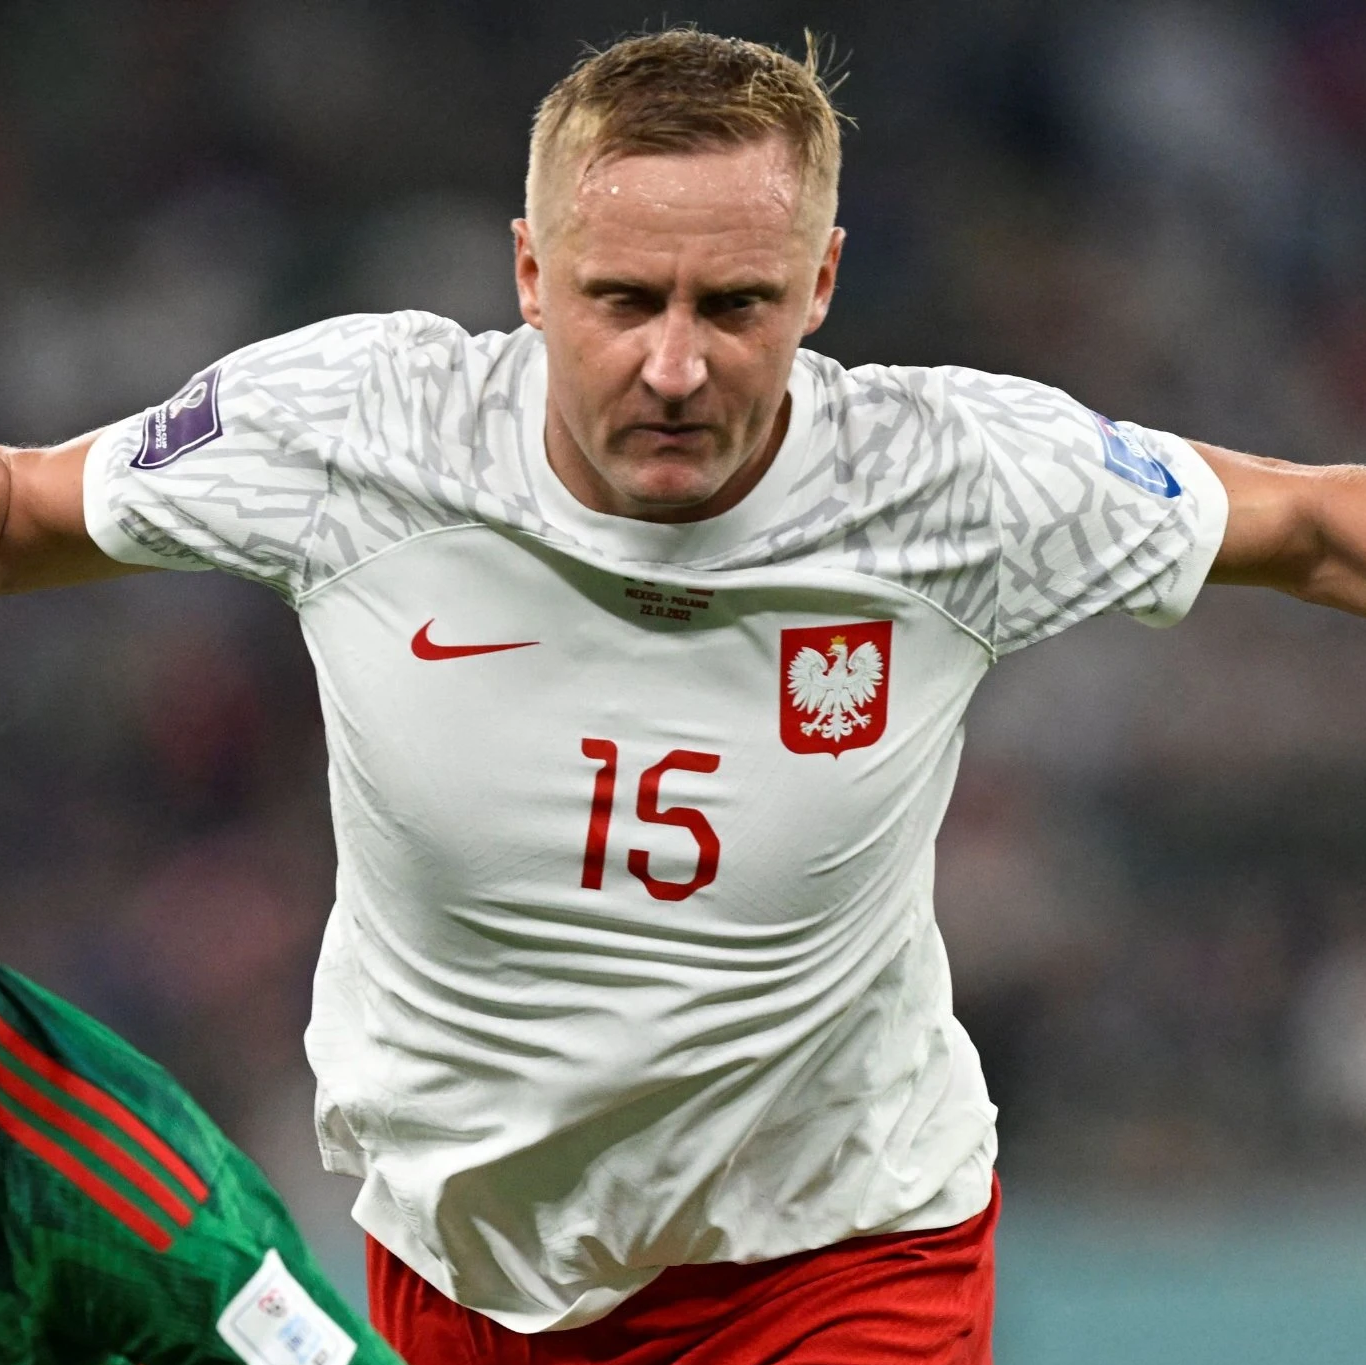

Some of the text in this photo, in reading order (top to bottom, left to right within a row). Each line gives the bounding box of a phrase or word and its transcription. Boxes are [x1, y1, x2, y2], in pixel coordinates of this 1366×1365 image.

[625, 587, 663, 602] MEXICO
[671, 596, 709, 609] POLAND
[640, 604, 692, 621] 22.11.2022
[581, 737, 720, 901] 15
